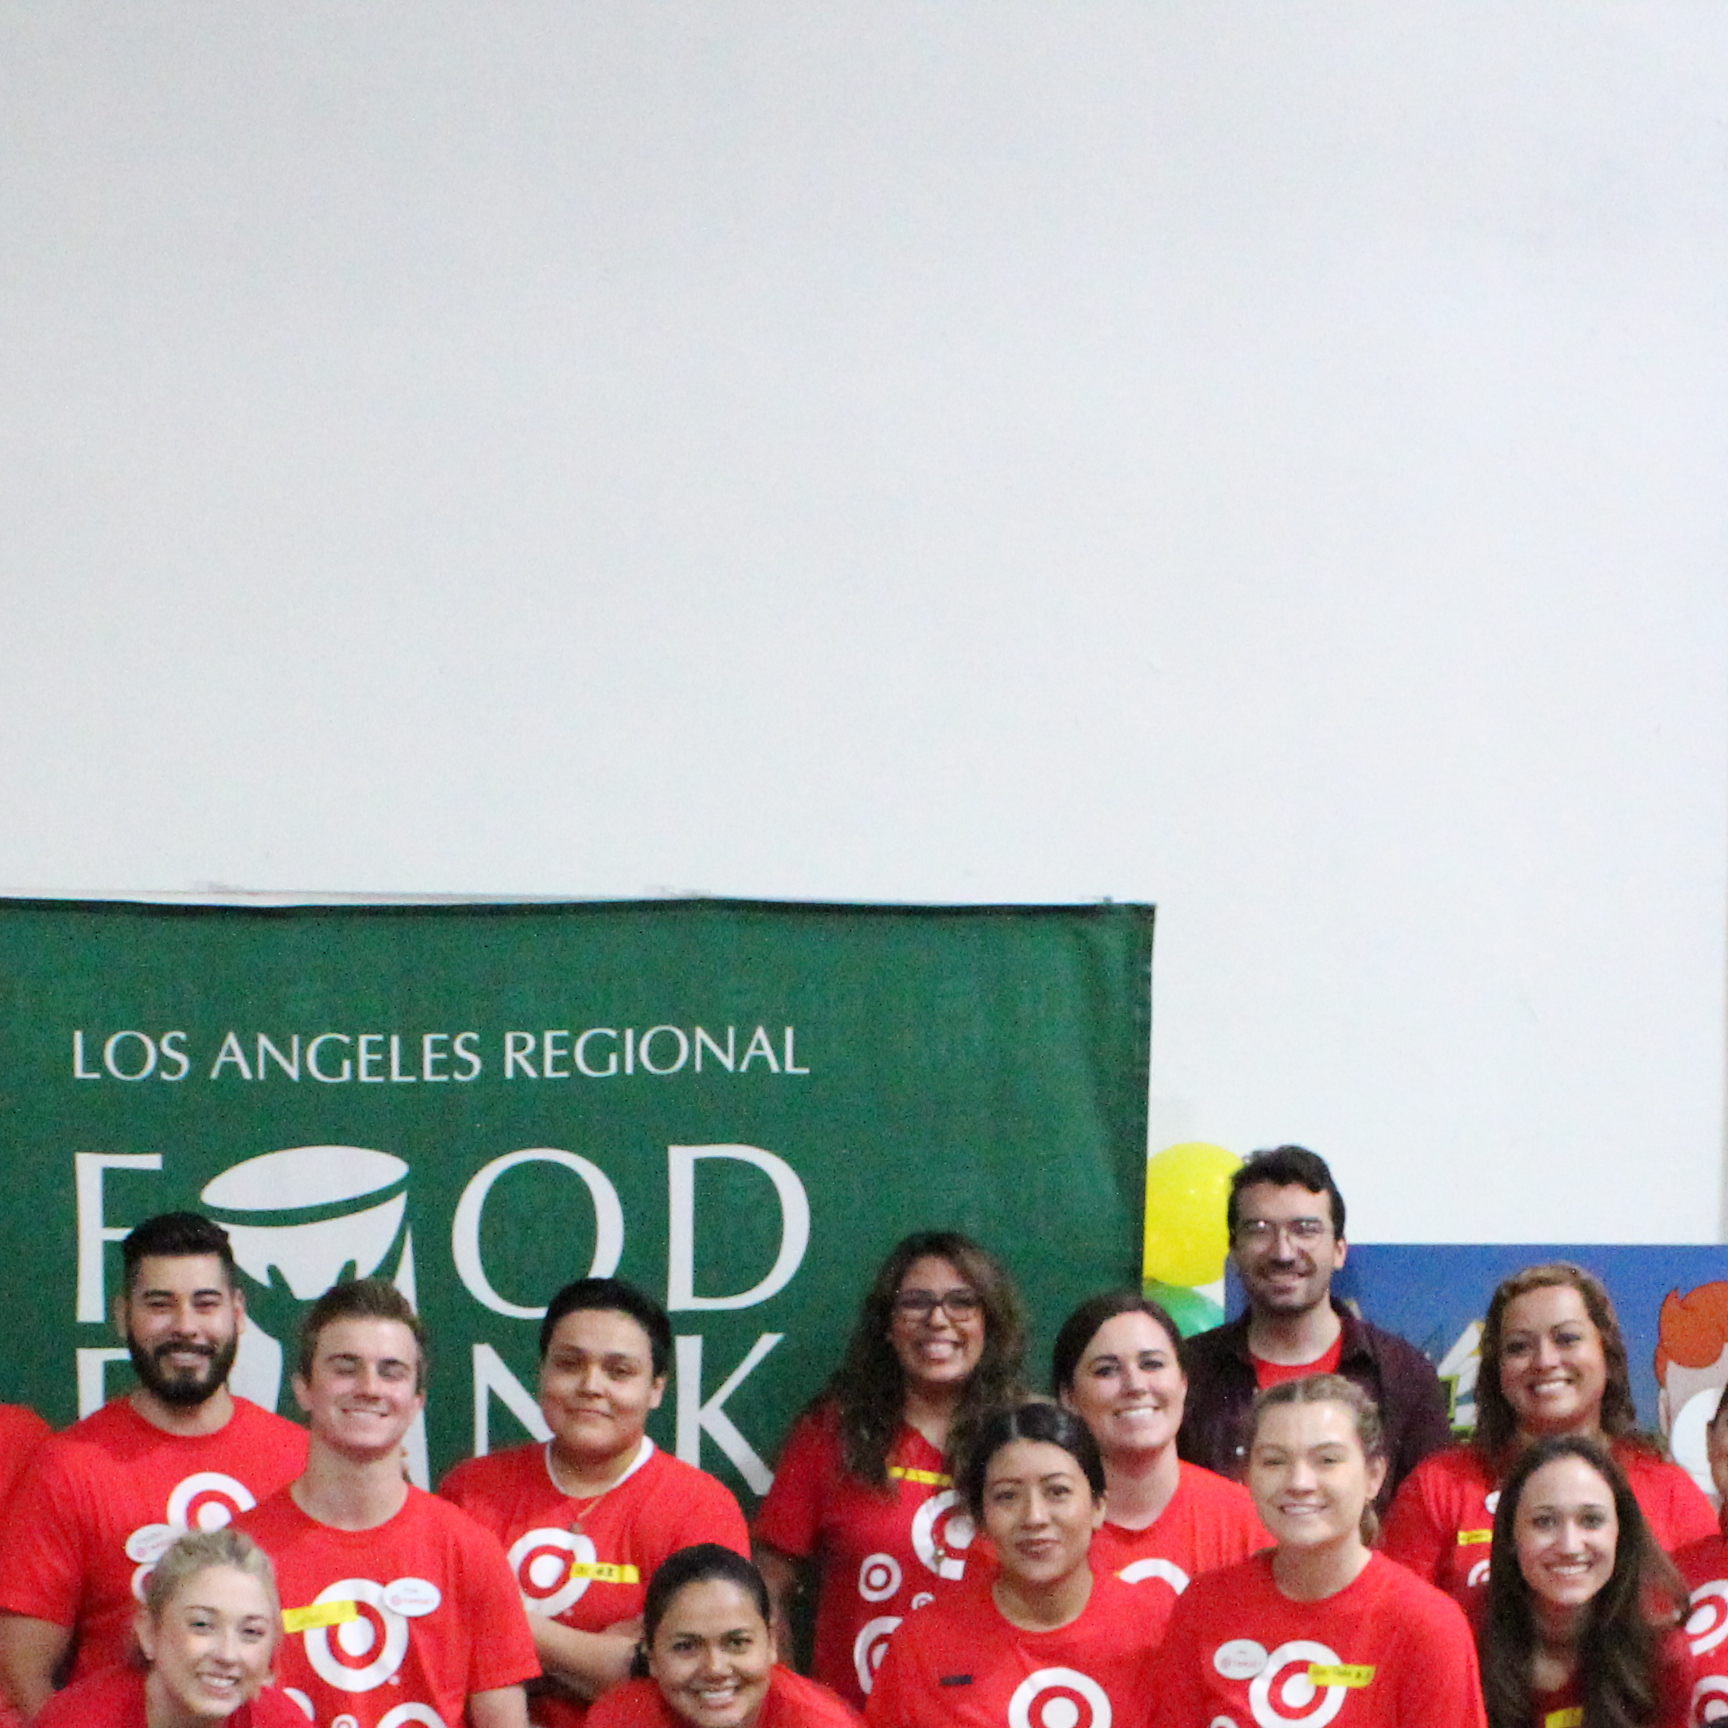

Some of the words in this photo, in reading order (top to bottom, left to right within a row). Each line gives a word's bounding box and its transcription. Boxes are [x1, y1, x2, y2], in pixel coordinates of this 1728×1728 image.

[73, 1029, 189, 1080] LOS
[210, 1031, 482, 1083] ANGELES
[504, 1025, 810, 1079] REGIONAL
